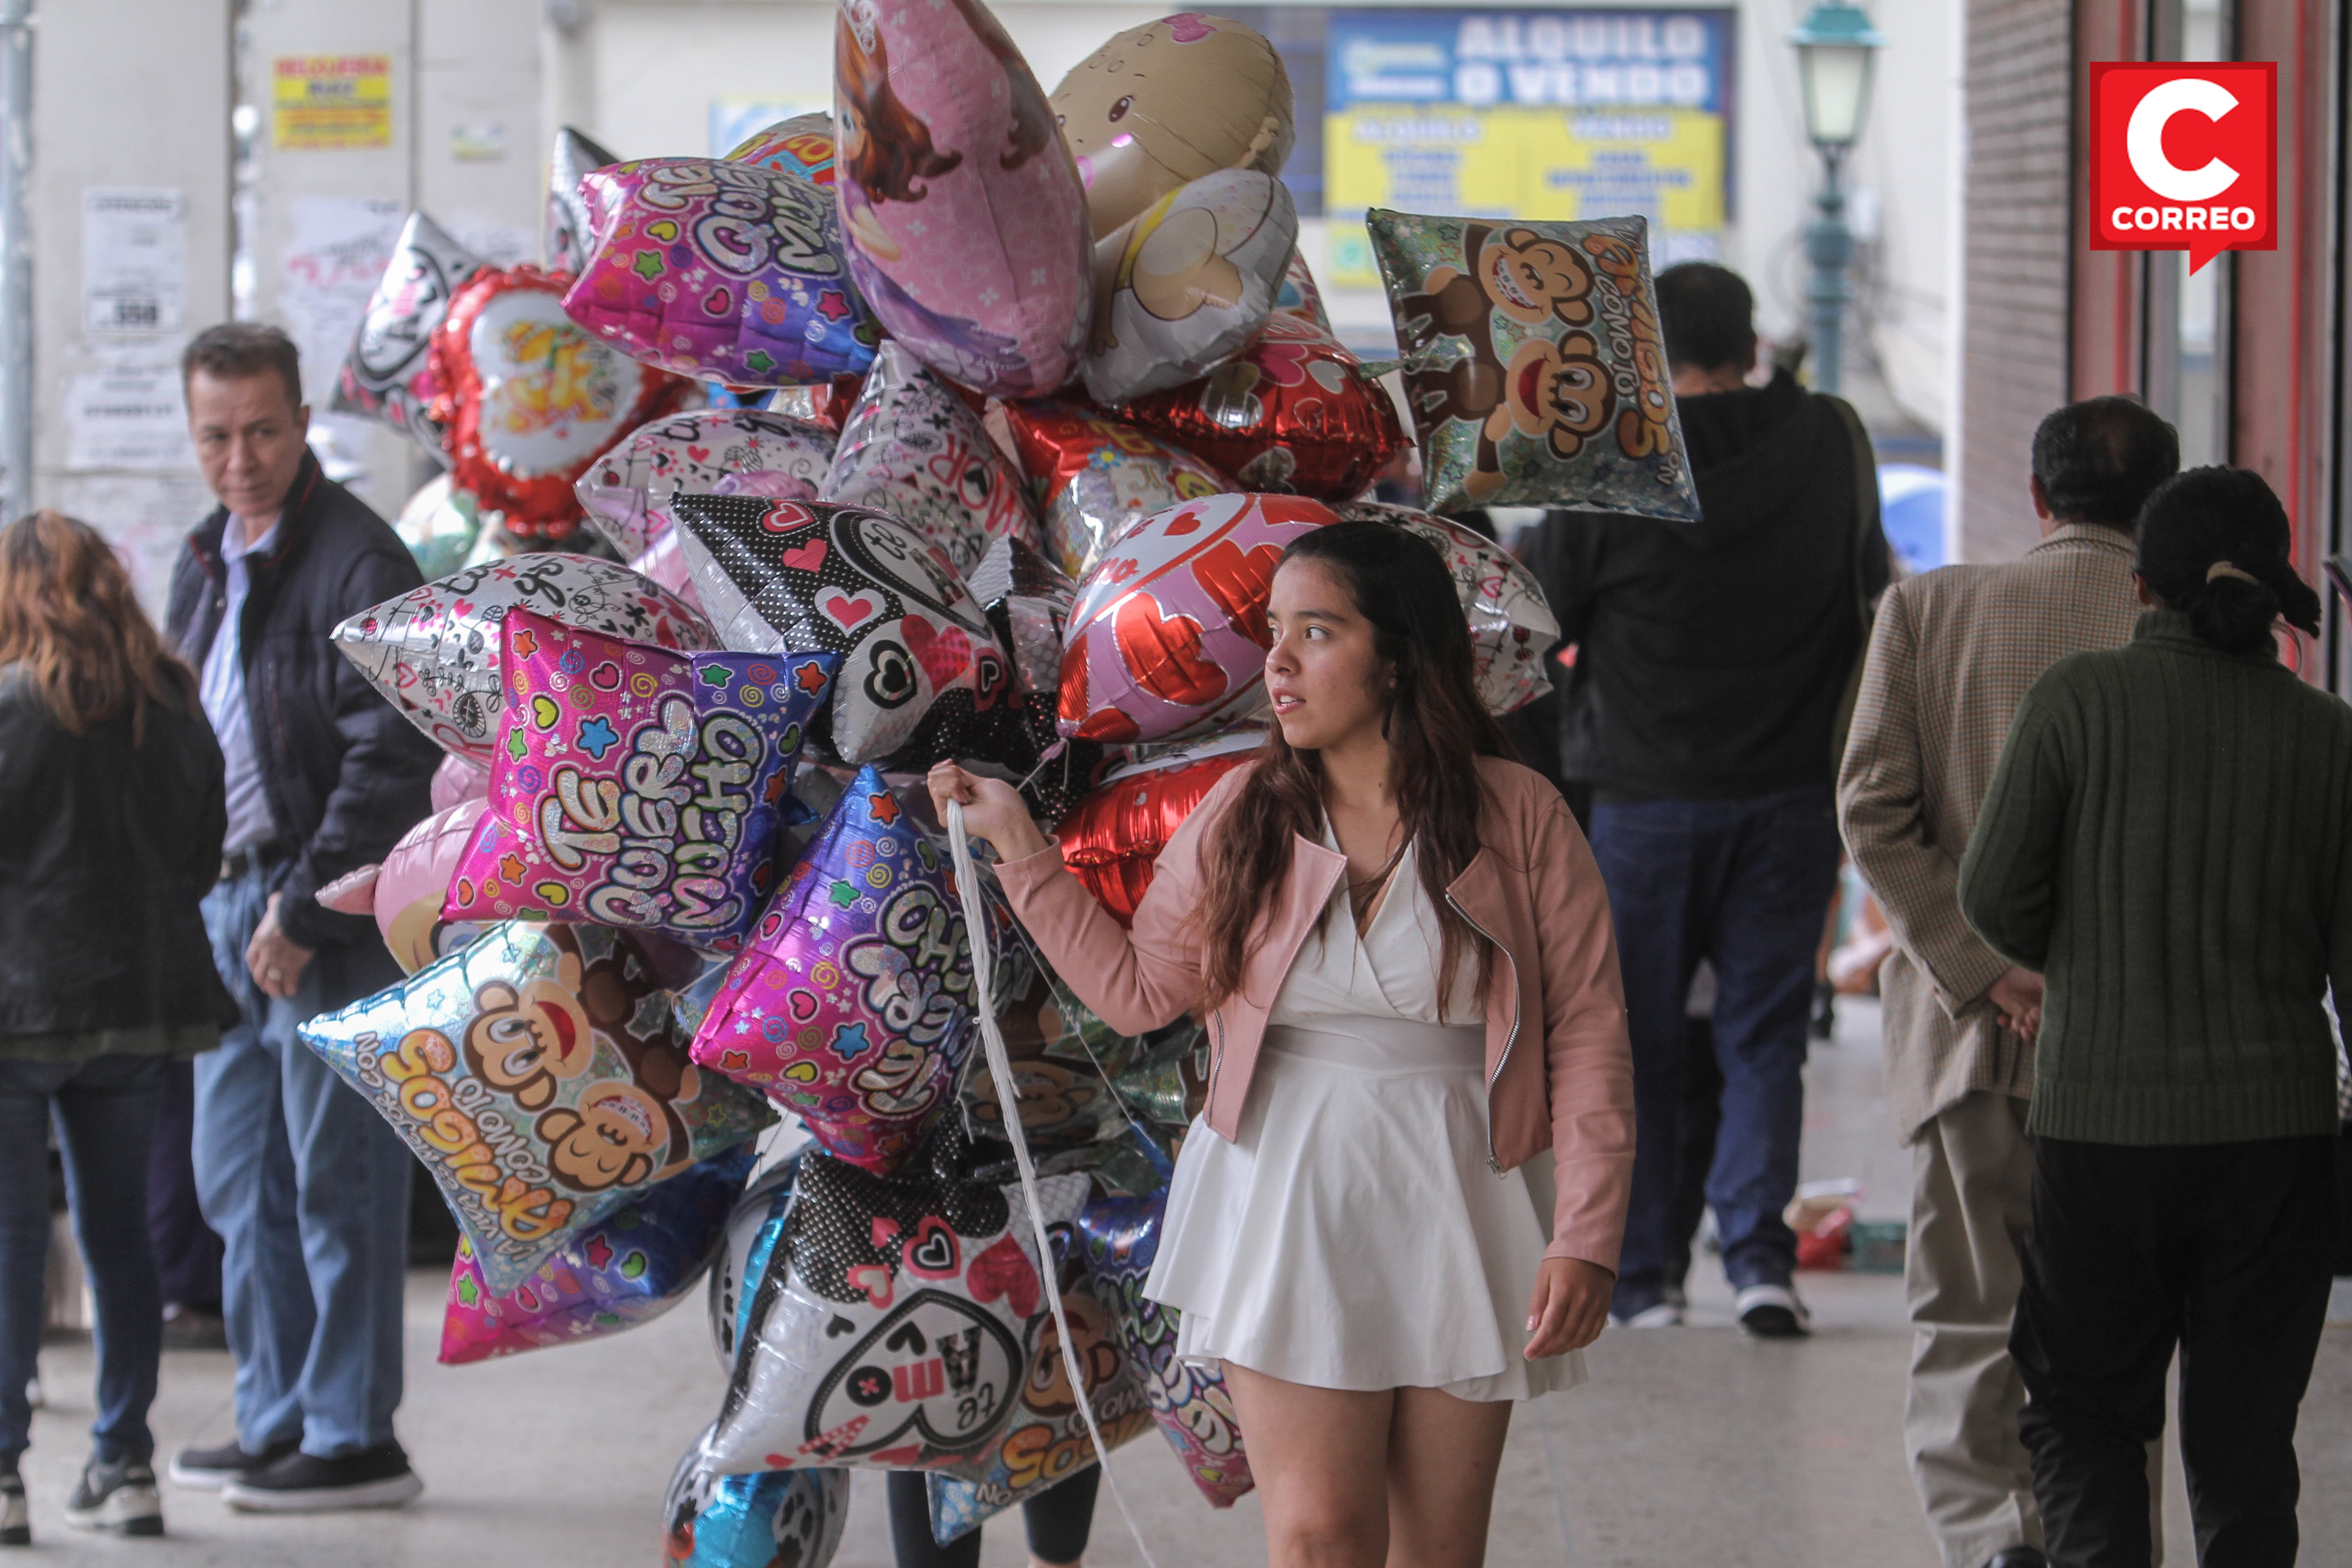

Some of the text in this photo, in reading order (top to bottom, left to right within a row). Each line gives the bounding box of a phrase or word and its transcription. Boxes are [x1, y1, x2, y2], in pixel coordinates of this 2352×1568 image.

[1455, 16, 1708, 60] ALQUILO
[1454, 63, 1502, 104] O
[1509, 63, 1711, 104] VENDO
[1581, 232, 1670, 460] AMIGOS
[1594, 272, 1633, 360] COMO
[540, 769, 622, 870] TE
[669, 715, 763, 930] MUCHO
[354, 1030, 387, 1091] CON
[853, 1038, 934, 1115] TE
[381, 1028, 578, 1243] AMIGOS
[482, 1112, 552, 1185] COMO
